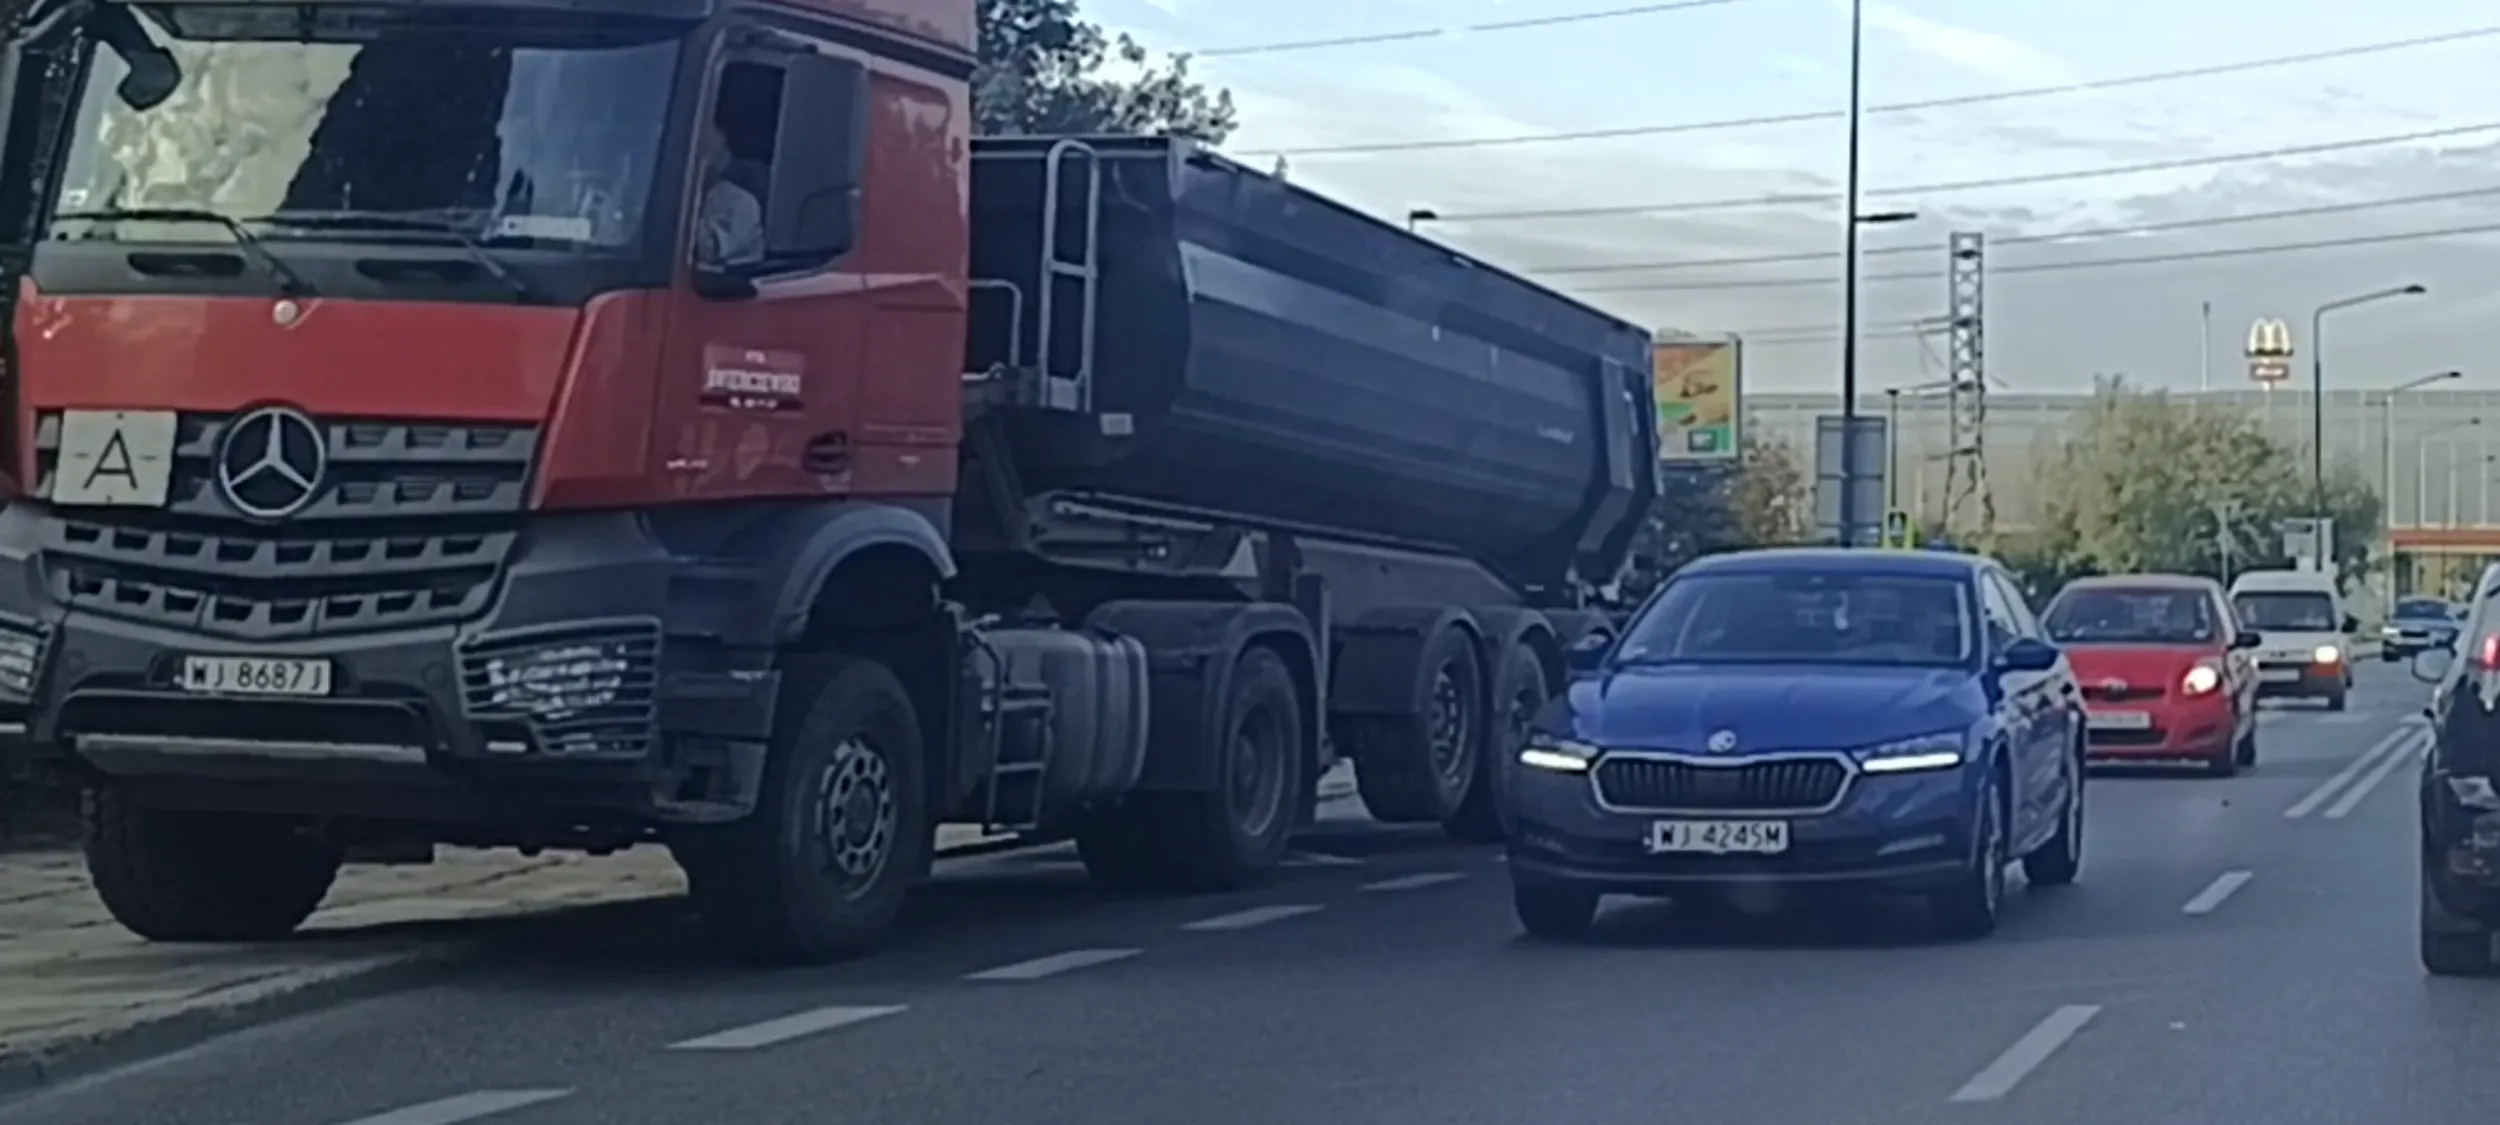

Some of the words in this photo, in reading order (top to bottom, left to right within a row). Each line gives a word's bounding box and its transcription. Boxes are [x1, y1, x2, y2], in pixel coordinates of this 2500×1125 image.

[83, 428, 139, 491] A
[192, 661, 225, 689] WJ
[237, 661, 322, 691] 8687J
[1660, 824, 1691, 848] WJ
[1702, 823, 1781, 849] 4245M
